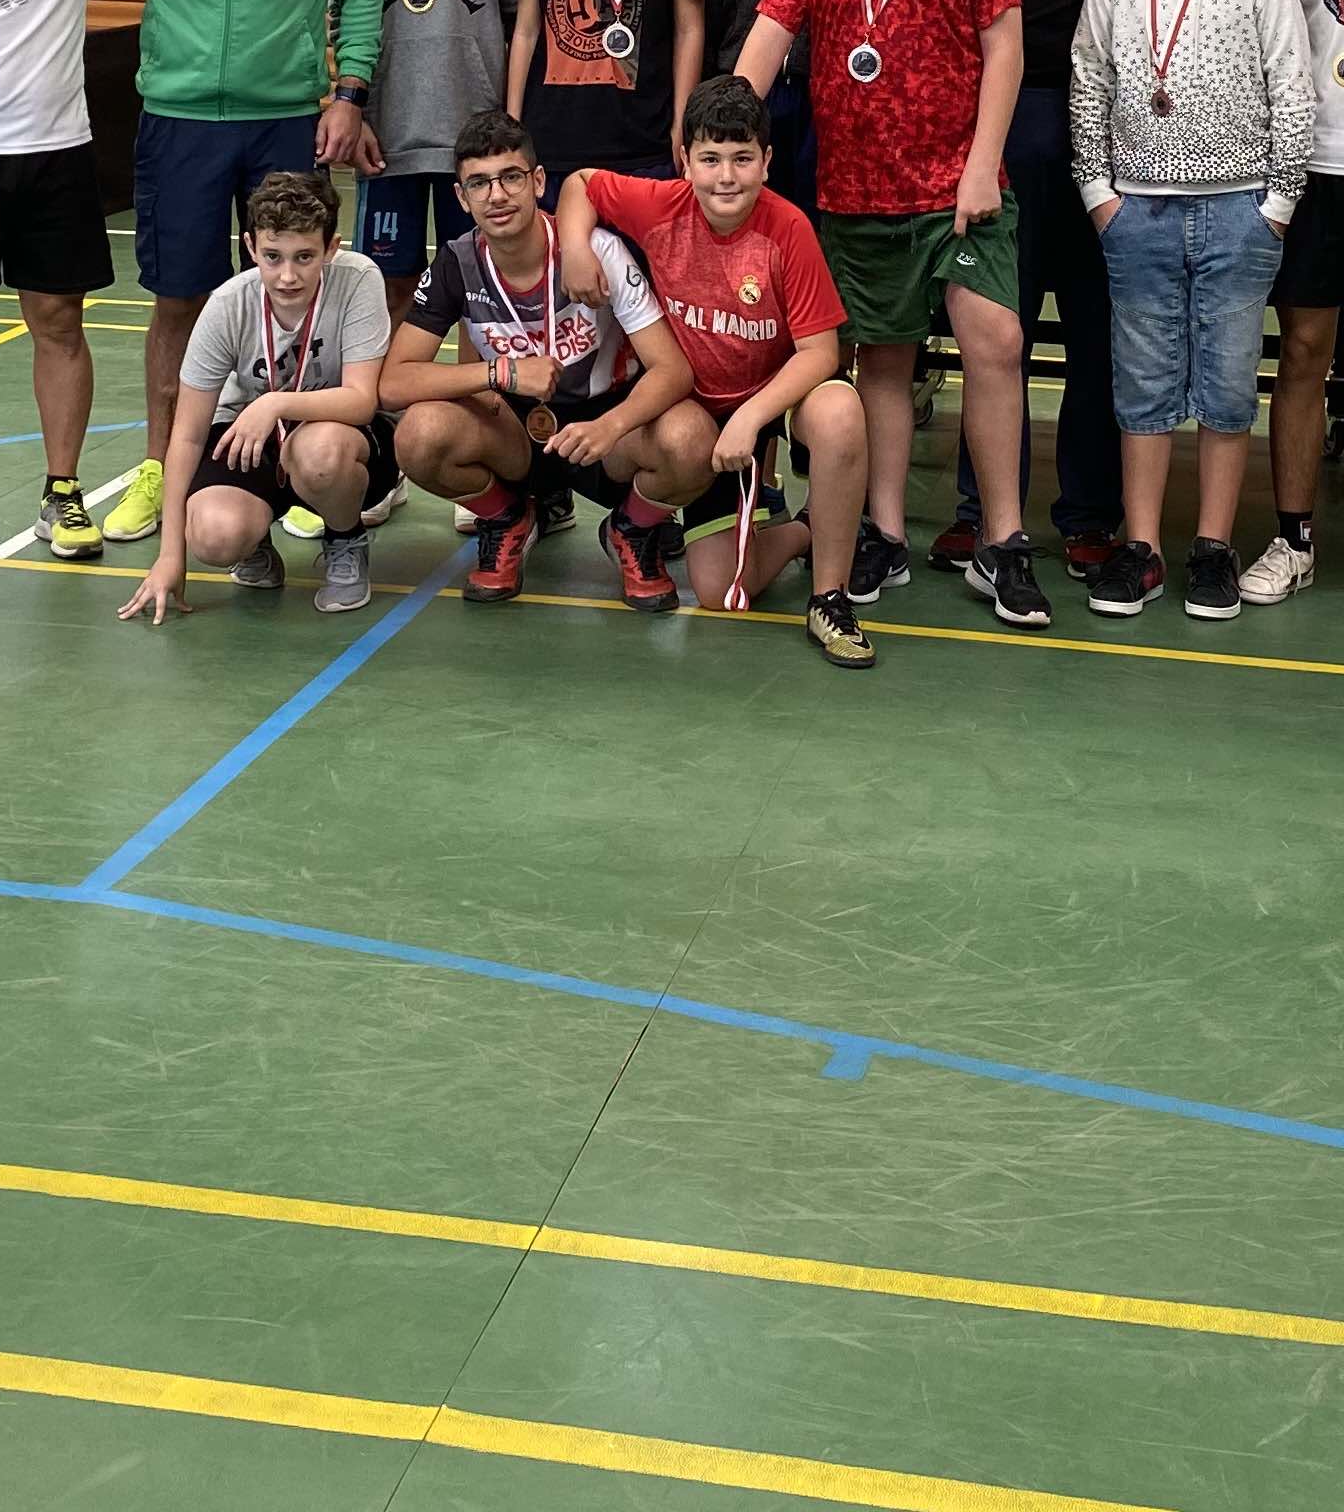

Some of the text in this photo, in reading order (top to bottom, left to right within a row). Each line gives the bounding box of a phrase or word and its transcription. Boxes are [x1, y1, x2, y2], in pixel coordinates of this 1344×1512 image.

[374, 212, 398, 240] 14
[665, 296, 707, 330] REAL
[712, 309, 777, 341] MADRID
